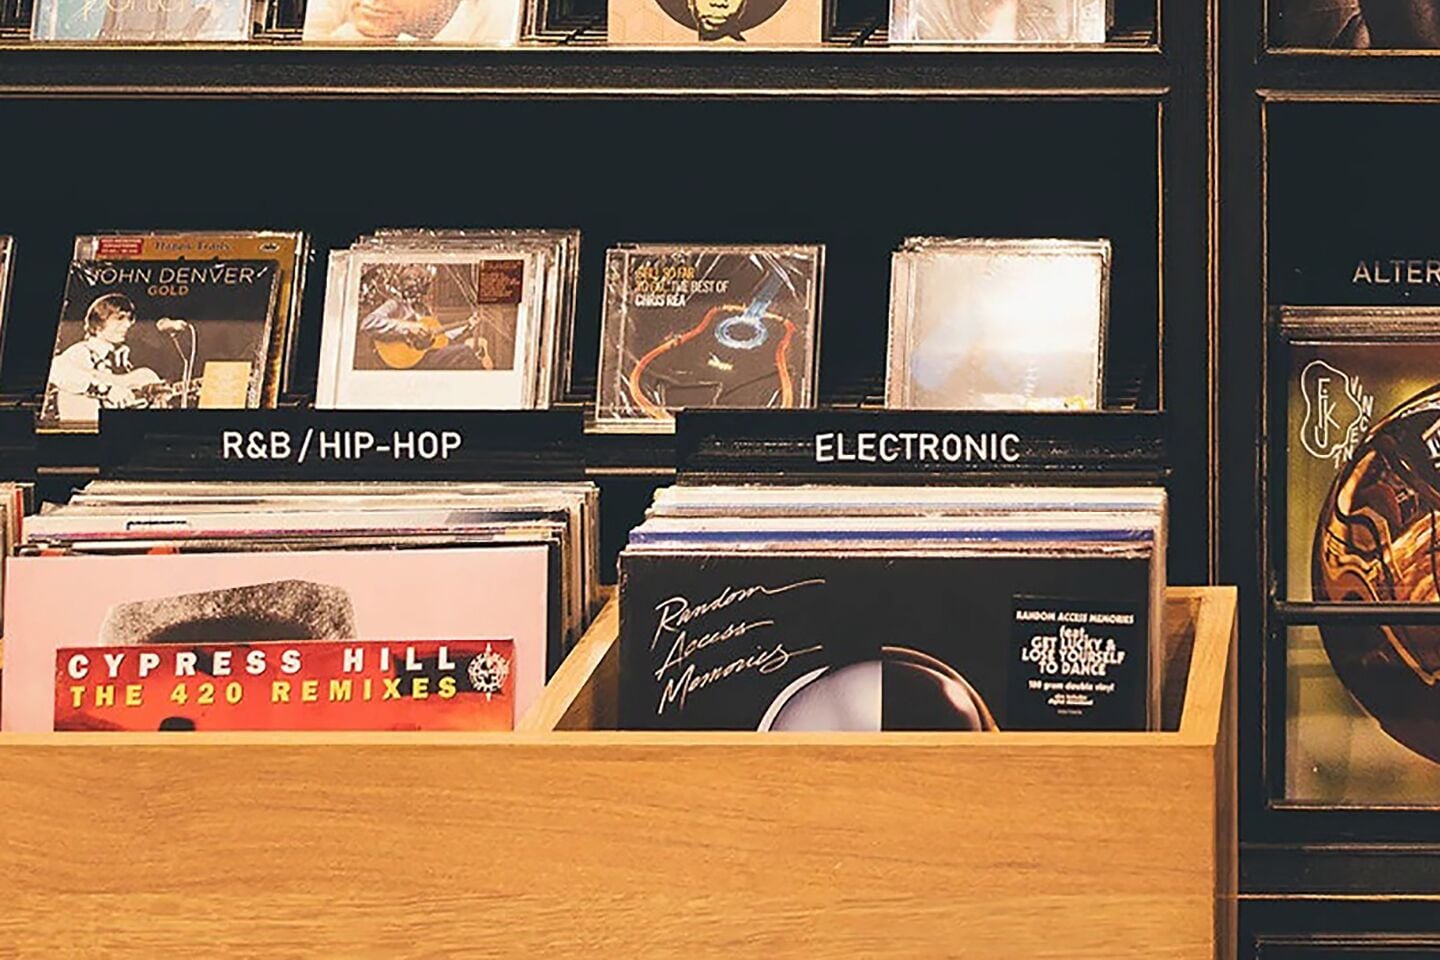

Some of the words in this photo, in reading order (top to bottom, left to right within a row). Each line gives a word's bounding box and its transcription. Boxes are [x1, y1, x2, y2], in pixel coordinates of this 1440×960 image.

[159, 267, 255, 284] DENVER
[147, 285, 189, 296] GOLD
[691, 280, 714, 294] BEST
[716, 280, 729, 293] OF
[667, 293, 686, 307] REA
[815, 433, 1021, 462] ELECTRONIC
[650, 578, 826, 652] Random
[1016, 610, 1056, 621] RANDOM
[1057, 611, 1088, 622] ACCESS
[1089, 613, 1134, 624] MEMORIES
[655, 620, 775, 681] Access
[1031, 636, 1058, 649] GET
[1061, 637, 1102, 652] LUCKY
[67, 648, 303, 679] CYPRESS
[342, 646, 457, 674] HILL
[1022, 648, 1056, 661] LOSE
[1059, 649, 1126, 664] YOURSELF
[1039, 660, 1058, 674] TO
[1061, 661, 1107, 676] DANCE
[657, 643, 824, 715] Memories
[69, 683, 144, 709] THE
[170, 682, 245, 707] 420
[271, 676, 460, 704] REMIXES
